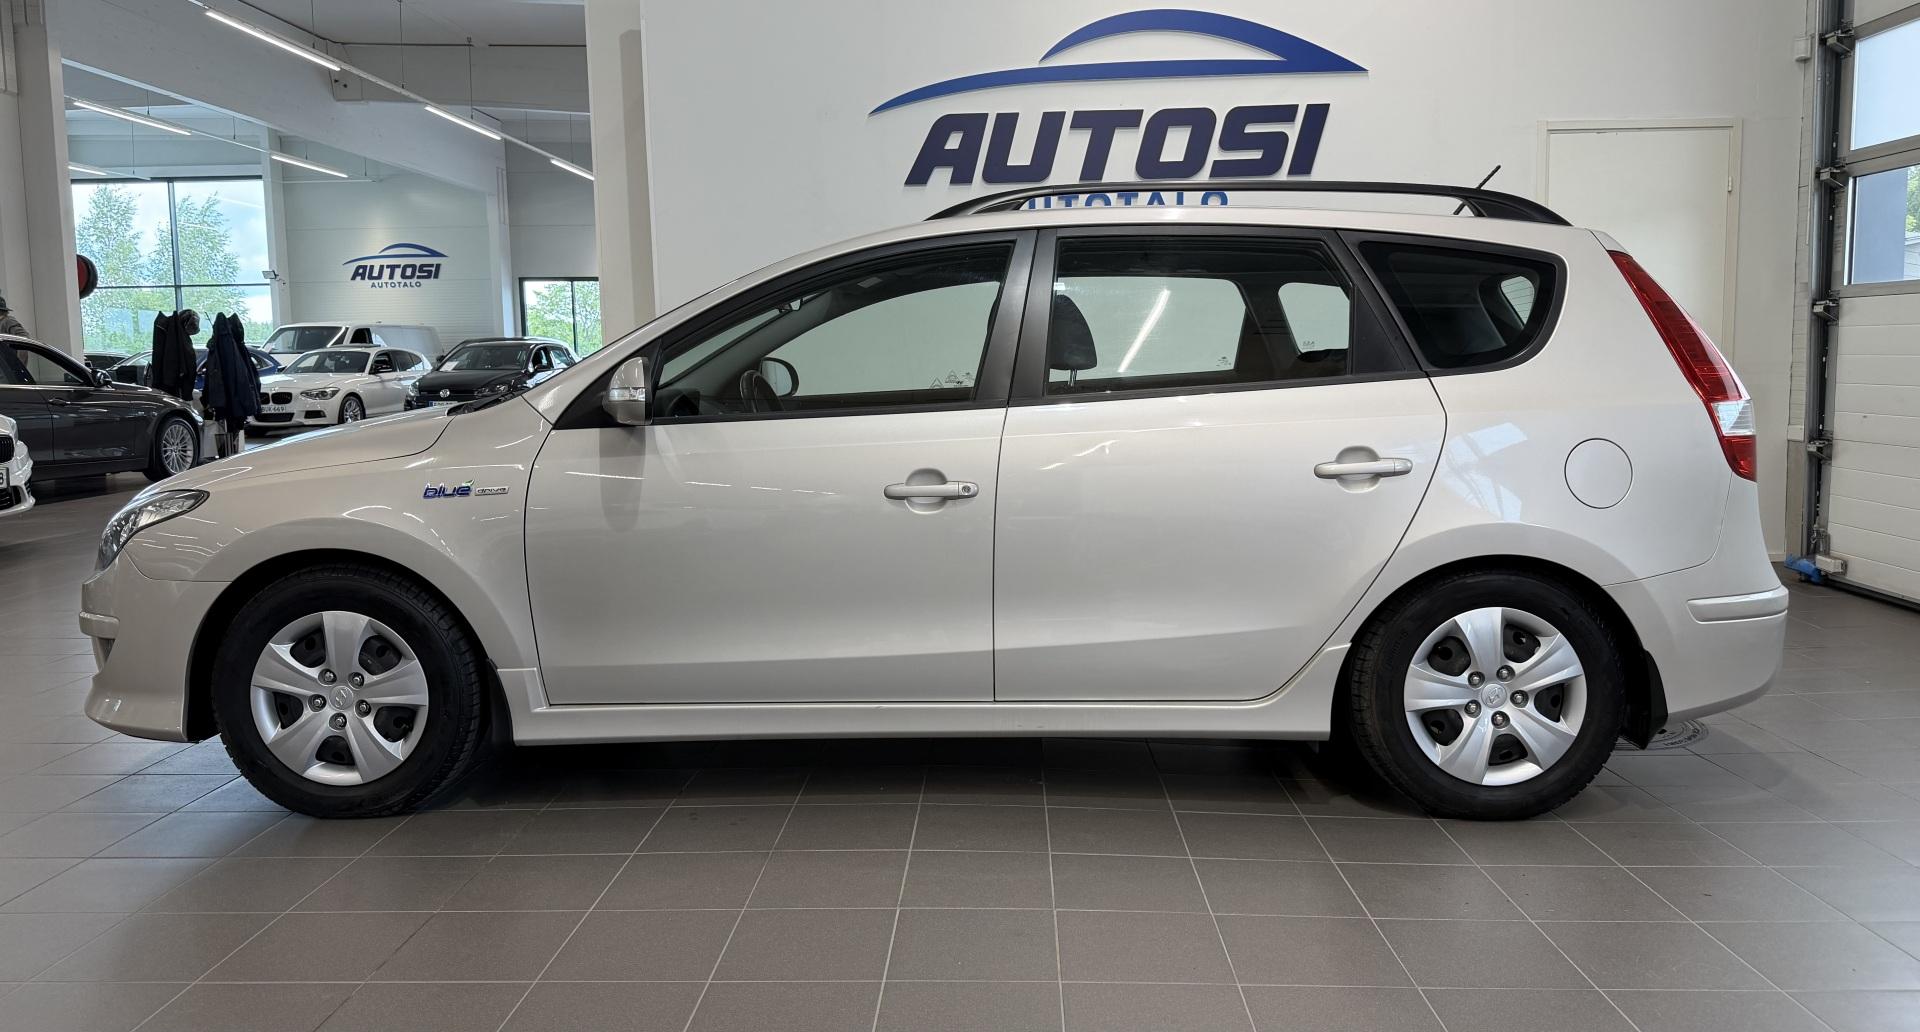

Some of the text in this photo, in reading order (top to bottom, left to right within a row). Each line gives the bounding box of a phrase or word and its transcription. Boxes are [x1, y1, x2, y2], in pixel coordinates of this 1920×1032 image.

[904, 104, 1330, 186] AUTOSI
[350, 263, 442, 280] AUTOSI
[370, 281, 422, 289] AUTOTALO
[423, 483, 472, 499] blue
